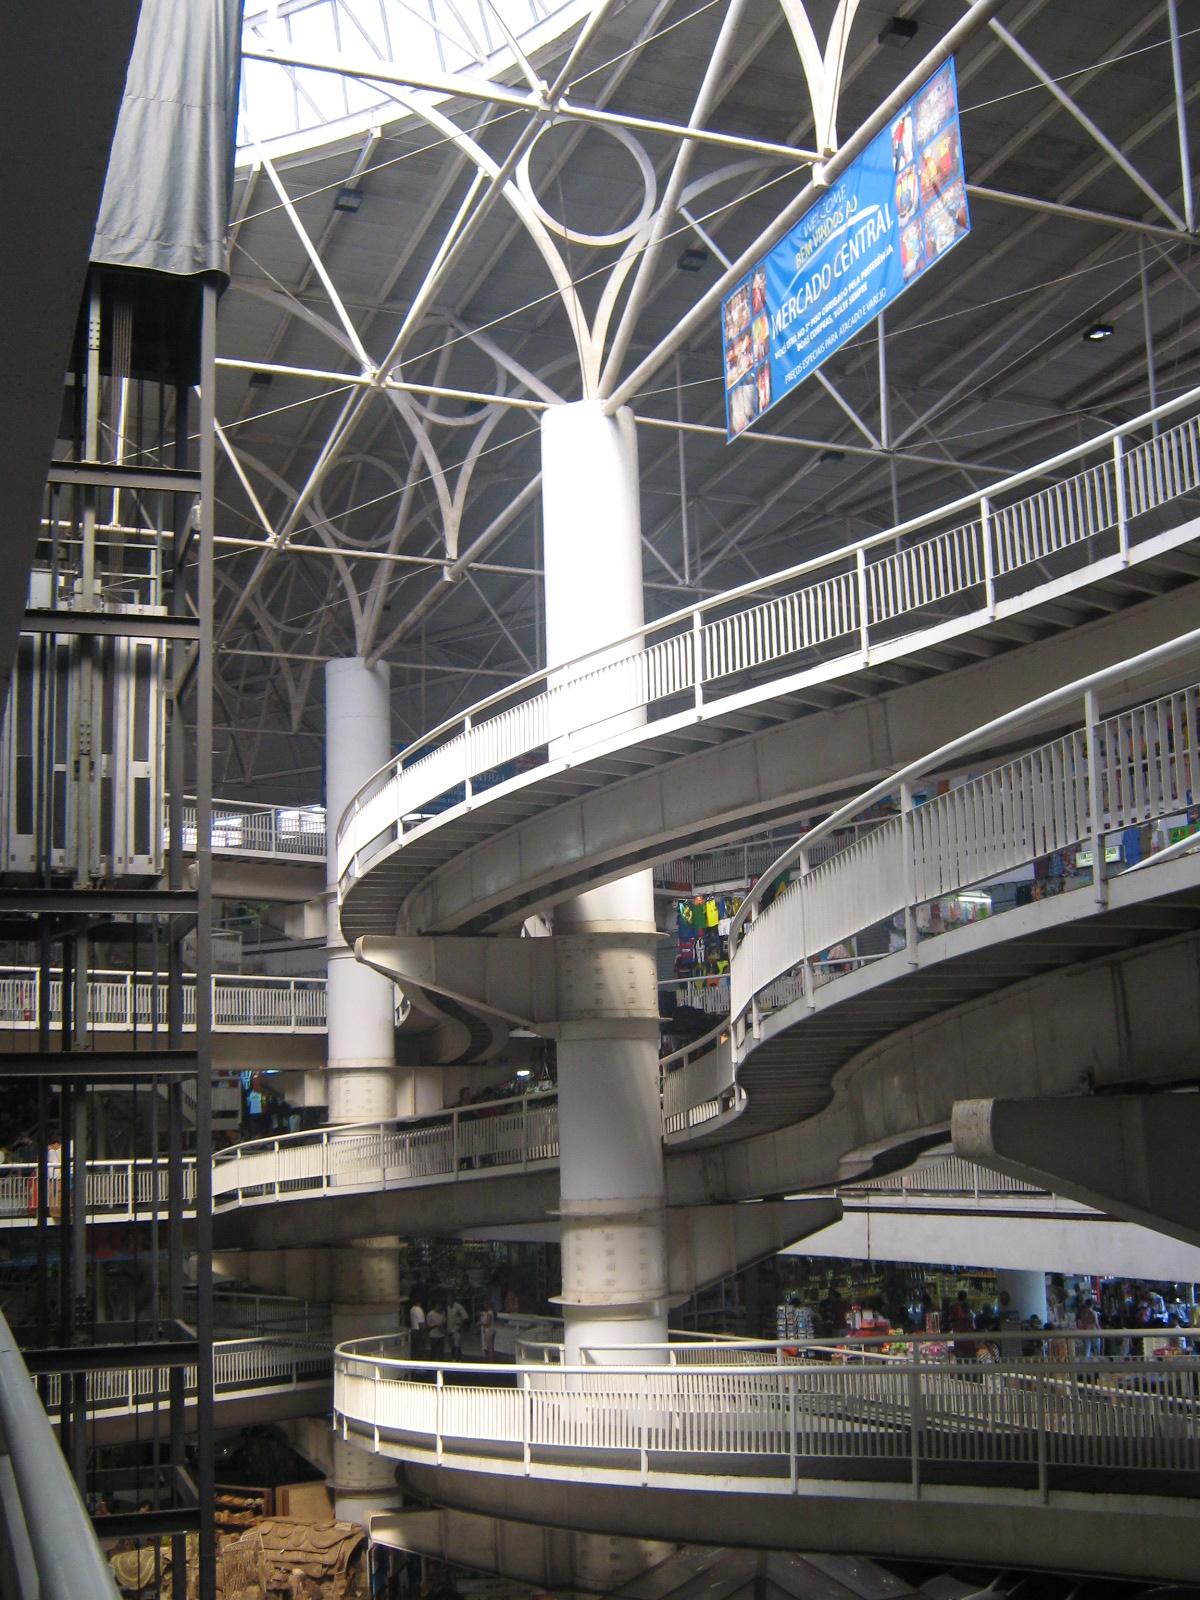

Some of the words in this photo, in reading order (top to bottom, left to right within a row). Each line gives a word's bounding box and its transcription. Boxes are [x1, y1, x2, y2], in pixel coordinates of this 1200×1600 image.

[803, 184, 847, 238] WELCOME
[771, 263, 832, 340] MERCADO
[833, 202, 894, 279] CENTRAL
[796, 239, 813, 270] BEM
